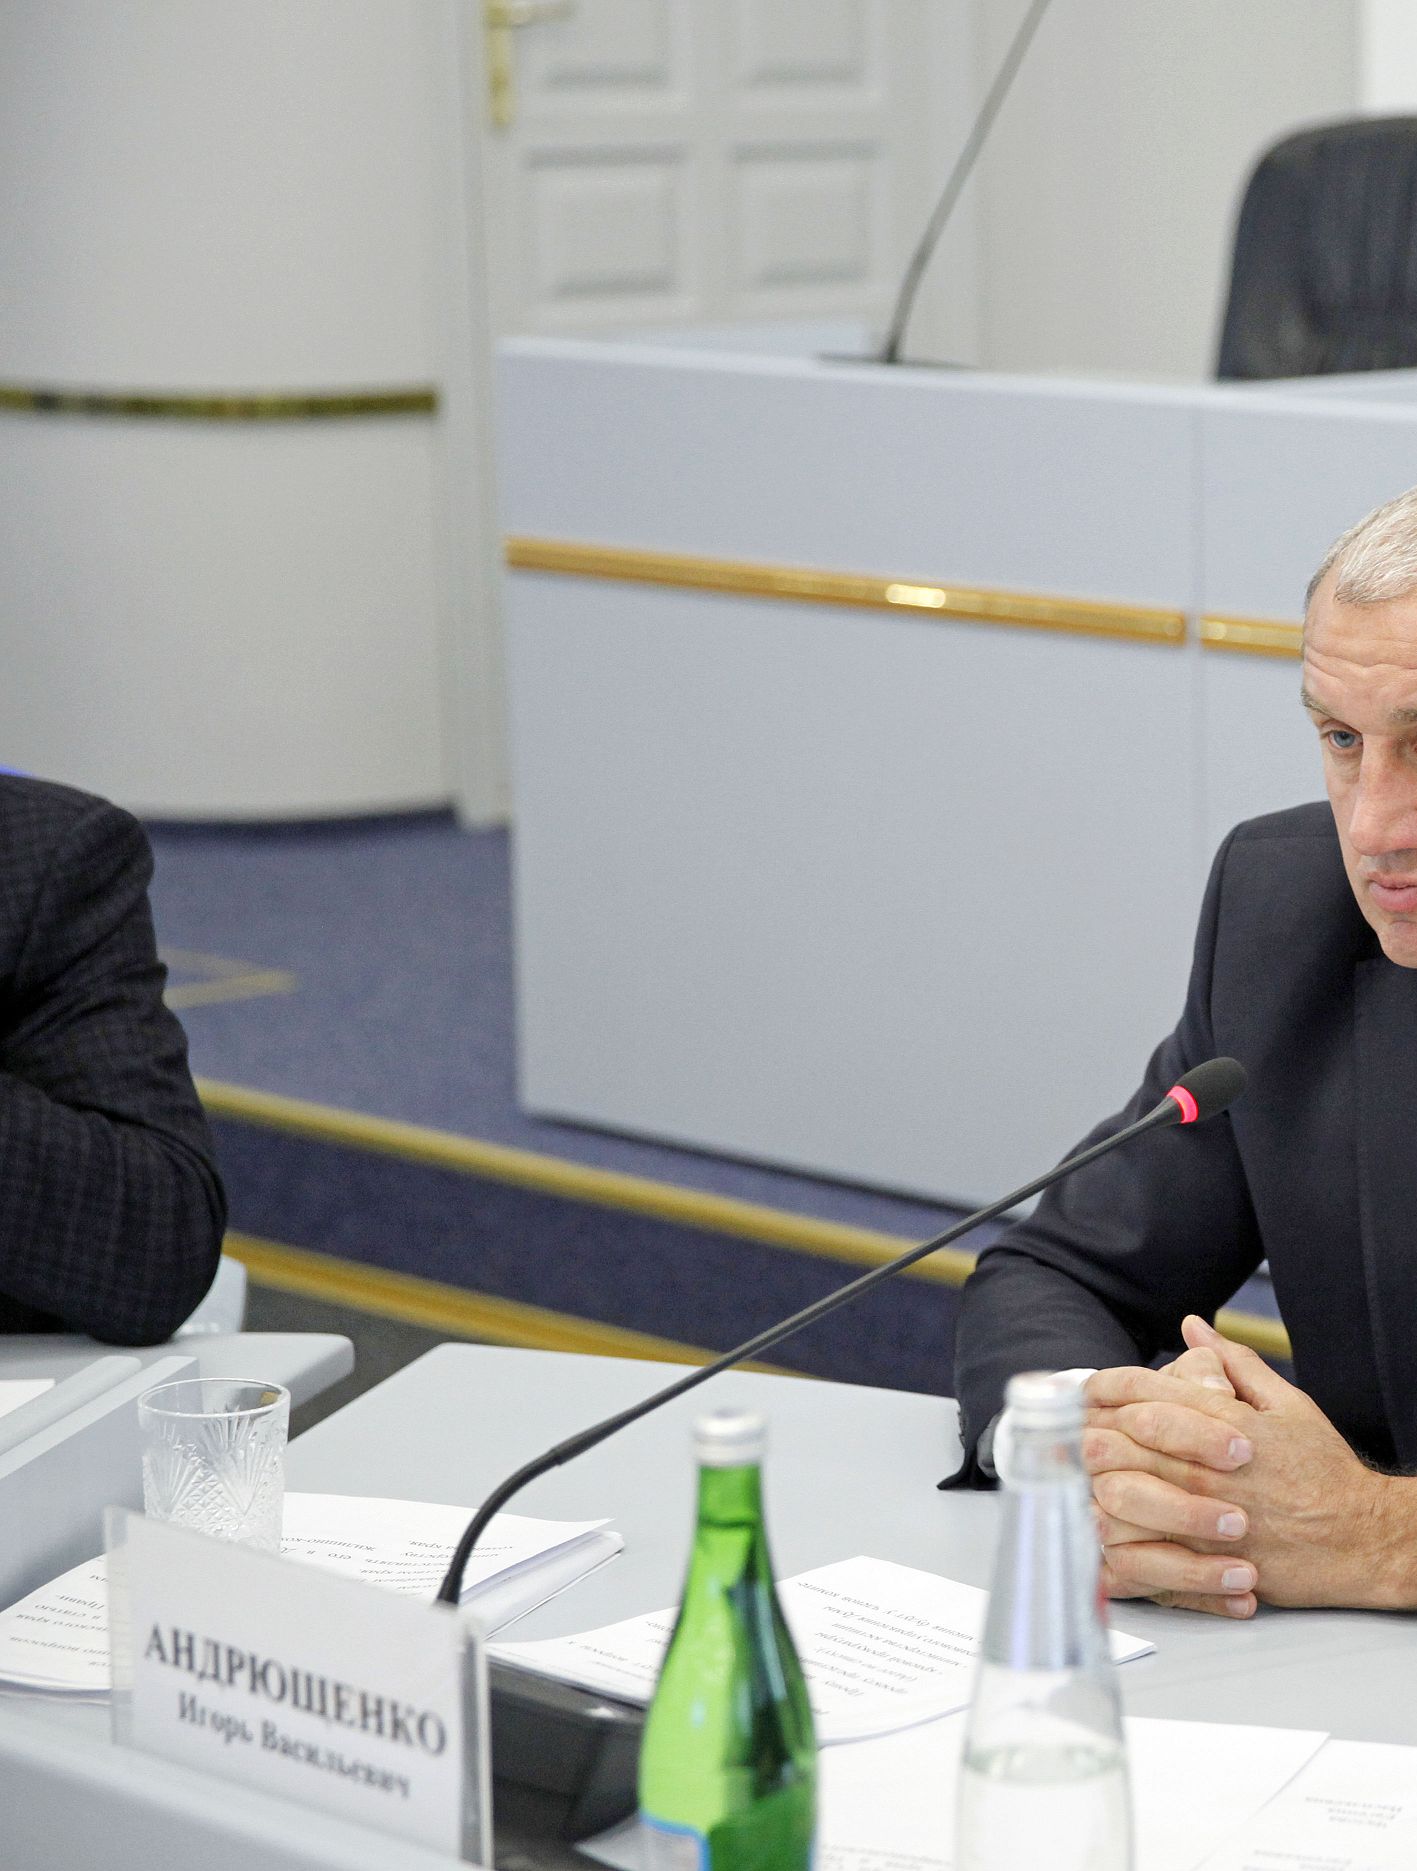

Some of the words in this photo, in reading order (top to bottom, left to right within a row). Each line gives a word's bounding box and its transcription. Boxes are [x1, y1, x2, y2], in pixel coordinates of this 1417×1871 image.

[327, 1552, 352, 1560] его
[145, 1621, 448, 1758] АНДРЮЩЕНКО
[177, 1690, 253, 1745] Игорь
[261, 1718, 411, 1800] Васильевич
